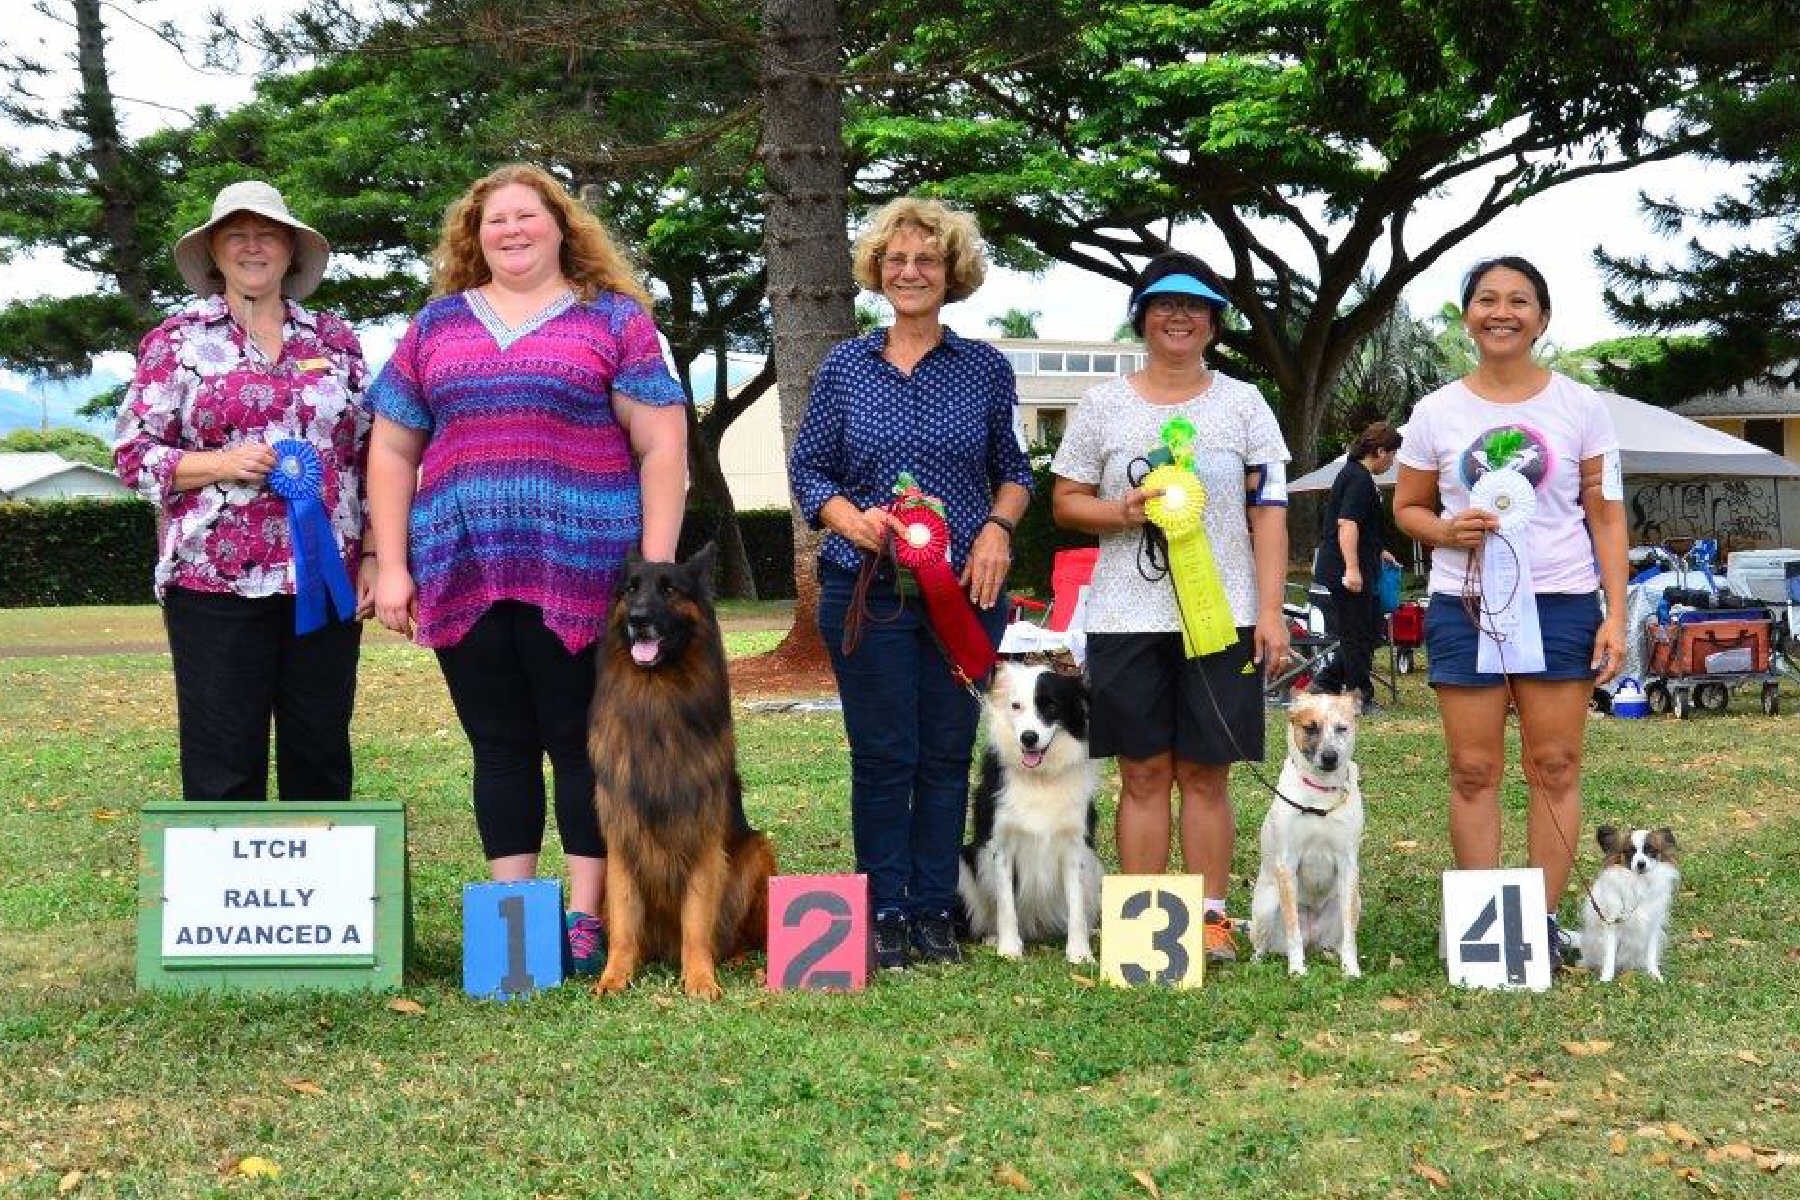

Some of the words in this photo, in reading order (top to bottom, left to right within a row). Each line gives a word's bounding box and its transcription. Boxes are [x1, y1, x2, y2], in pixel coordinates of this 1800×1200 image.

[233, 840, 307, 859] LTCH
[176, 925, 332, 945] ADVANCED
[341, 924, 361, 944] A
[223, 888, 315, 908] RALLY
[498, 896, 534, 993] 1
[782, 891, 852, 987] 2
[1120, 890, 1190, 985] 3
[1459, 884, 1532, 983] 4
